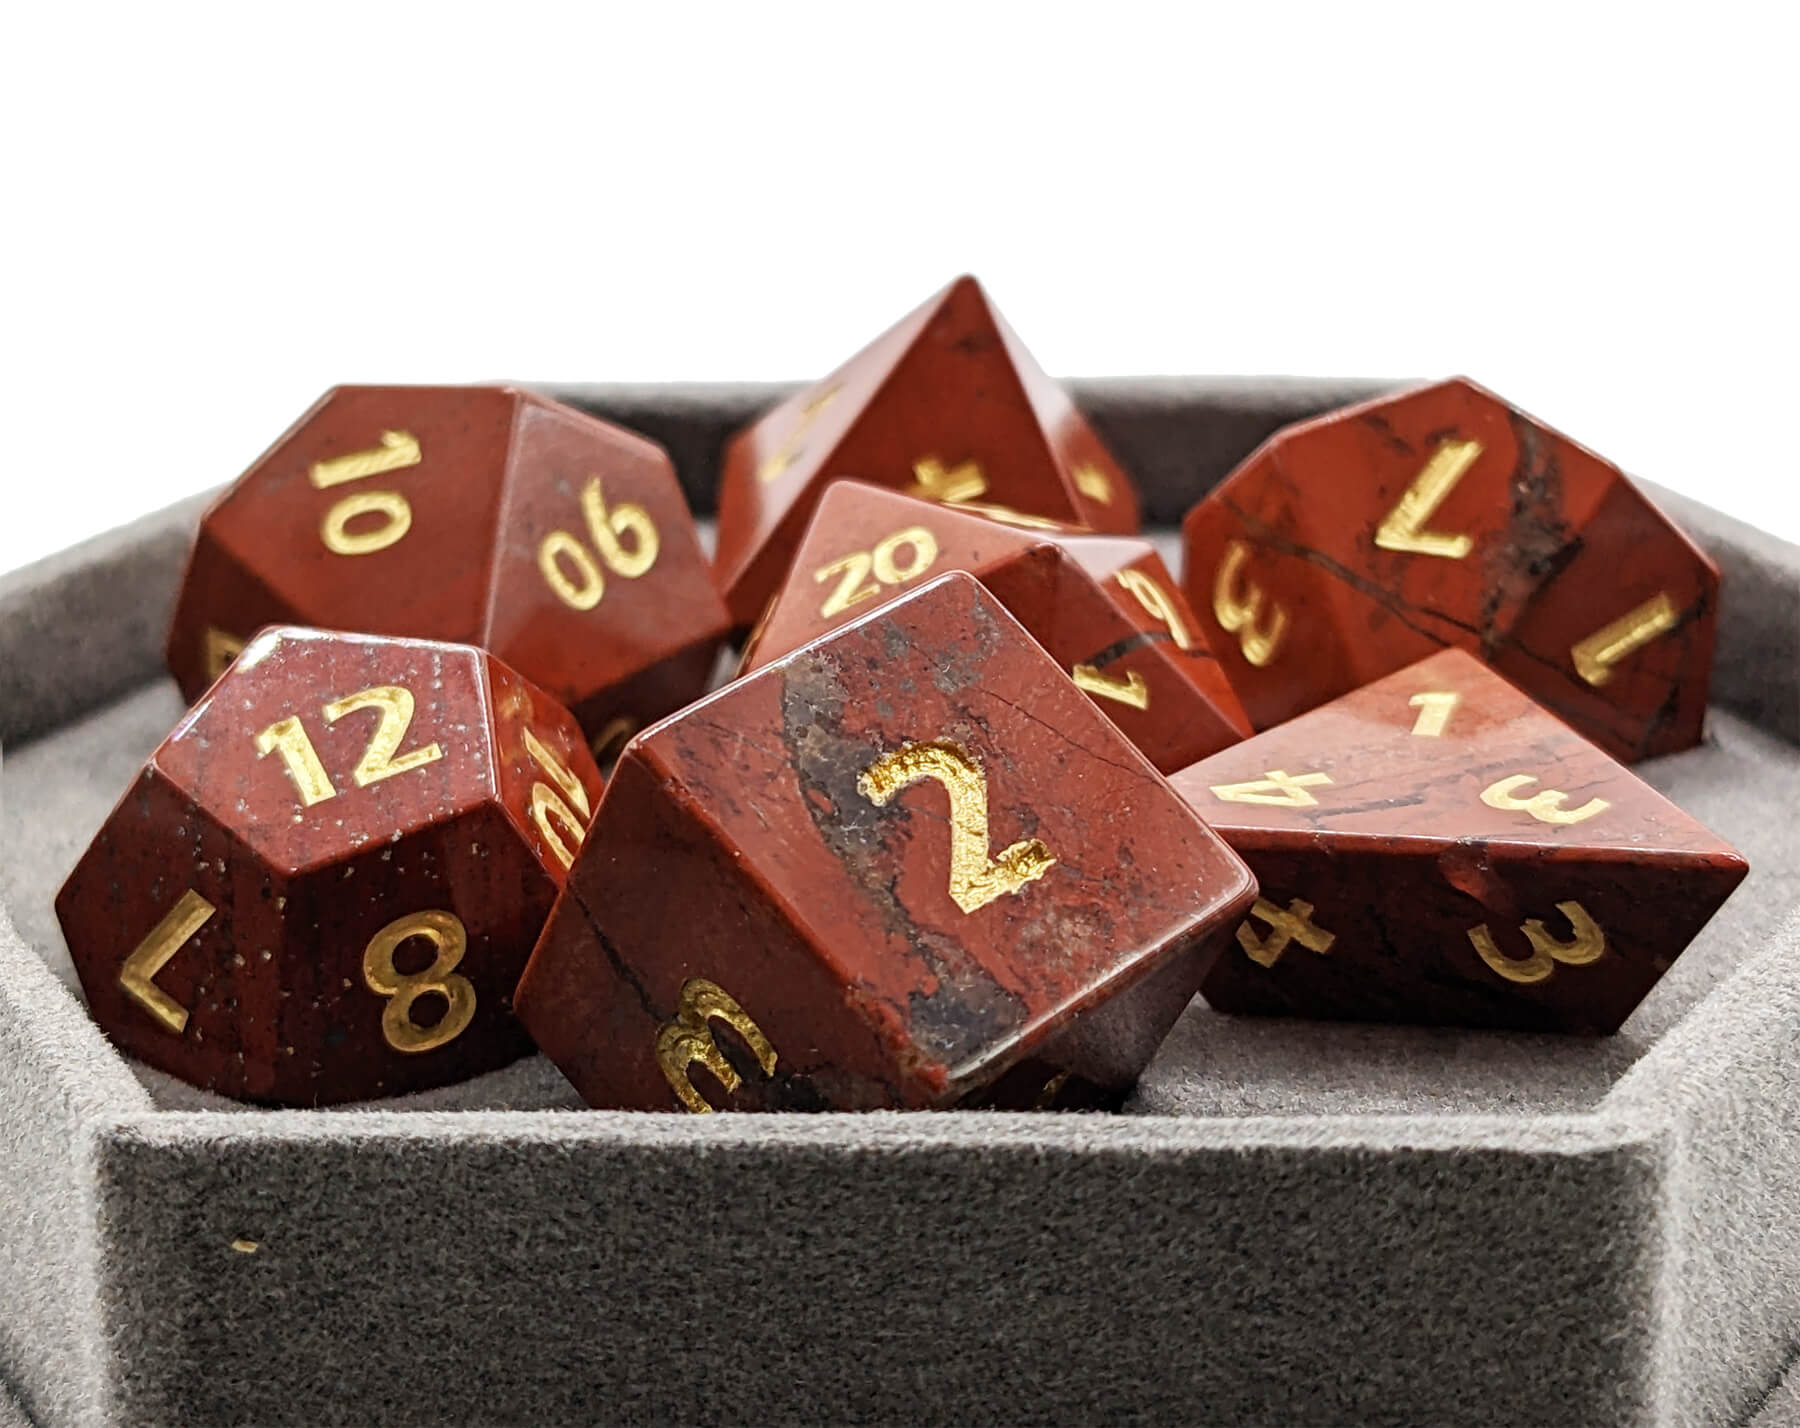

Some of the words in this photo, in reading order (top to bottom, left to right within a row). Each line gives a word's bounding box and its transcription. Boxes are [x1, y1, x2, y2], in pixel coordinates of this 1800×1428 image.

[309, 430, 422, 556] 10
[1374, 440, 1485, 559] 7
[814, 526, 938, 618] 20
[1213, 542, 1287, 667] 3
[1571, 591, 1677, 686] 1
[256, 685, 443, 807] 12
[1408, 692, 1462, 737] 1
[855, 735, 1057, 914] 2
[1209, 769, 1335, 806] 4
[1479, 773, 1612, 825] 3
[119, 888, 216, 1034] 7
[363, 909, 477, 1053] 8
[1235, 896, 1337, 968] 4
[1467, 900, 1607, 984] 3
